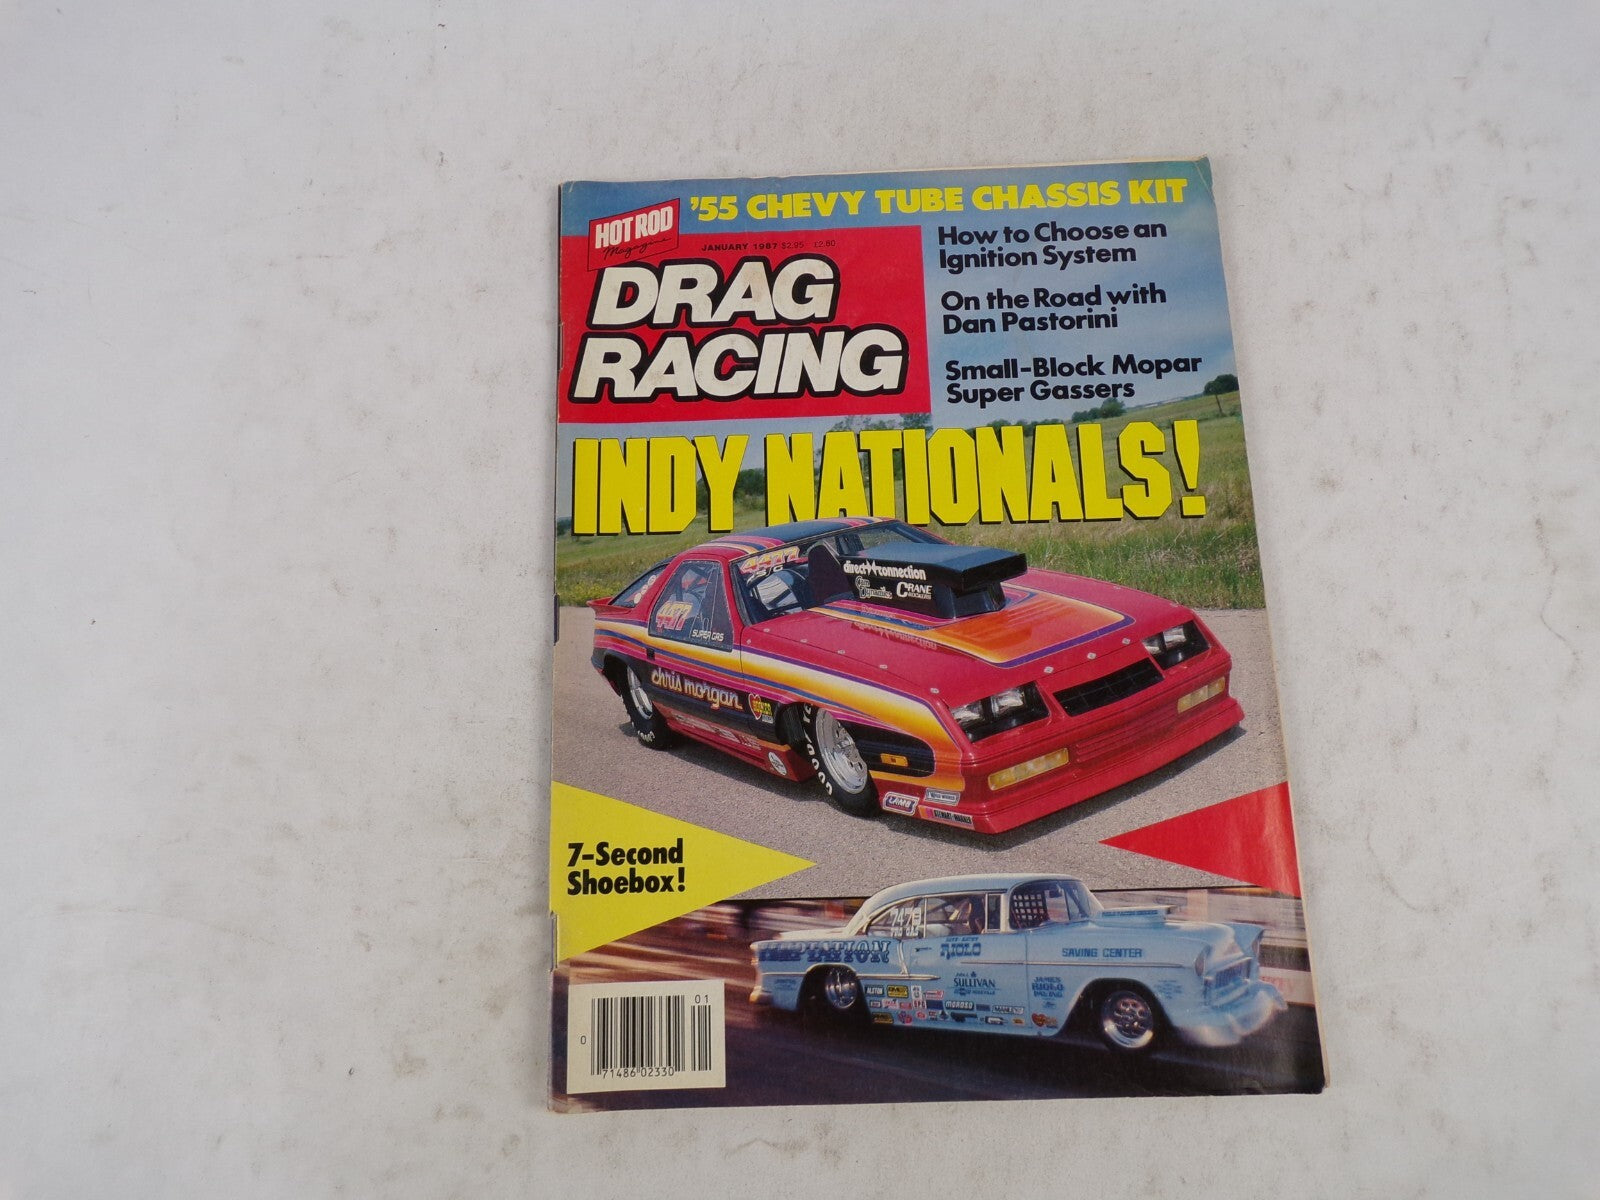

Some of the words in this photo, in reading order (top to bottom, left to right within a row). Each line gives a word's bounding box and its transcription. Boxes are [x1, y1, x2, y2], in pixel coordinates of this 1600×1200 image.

[691, 196, 738, 222] '55
[747, 190, 866, 219] CHEVY
[875, 187, 964, 213] TUBE
[971, 180, 1121, 210] CHASSIS
[1128, 178, 1188, 204] KIT
[595, 217, 633, 249] HOT
[635, 206, 673, 239] ROD
[938, 225, 998, 246] How
[1003, 225, 1030, 244] to
[1034, 221, 1129, 243] Choose
[1134, 222, 1167, 239] an
[603, 238, 672, 260] Magazine
[701, 243, 748, 251] JANUARY
[753, 242, 778, 250] 1987
[781, 241, 804, 250] $2.95
[940, 246, 1038, 275] Ignition
[1043, 245, 1136, 271] System
[587, 254, 840, 329] DRAG
[941, 290, 980, 312] On
[986, 288, 1030, 309] the
[1033, 285, 1102, 308] Road
[1107, 282, 1167, 305] with
[943, 313, 996, 335] Dan
[1002, 307, 1118, 332] Pastorini
[568, 324, 907, 403] RACING
[945, 357, 1104, 381] Small-Block
[1111, 353, 1202, 380] Mopar
[946, 382, 1024, 408] Super
[1030, 379, 1135, 401] Gassers
[571, 434, 750, 536] INDY
[764, 419, 1206, 527] NATIONALS!
[843, 560, 871, 576] direct
[874, 563, 927, 580] connection
[896, 581, 933, 598] CRANE
[692, 628, 711, 640] SUPER
[711, 631, 725, 642] GAS
[652, 667, 683, 692] chris
[684, 678, 744, 711] morgan
[567, 838, 684, 867] 7-Second
[567, 867, 686, 896] Shoebox!
[1062, 948, 1098, 958] SAVING
[1103, 948, 1142, 958] CENTER
[954, 977, 996, 989] SULLIVAN
[695, 994, 710, 1004] 01
[580, 1035, 587, 1045] 0
[602, 1068, 637, 1080] 71486
[640, 1067, 675, 1078] 02330
